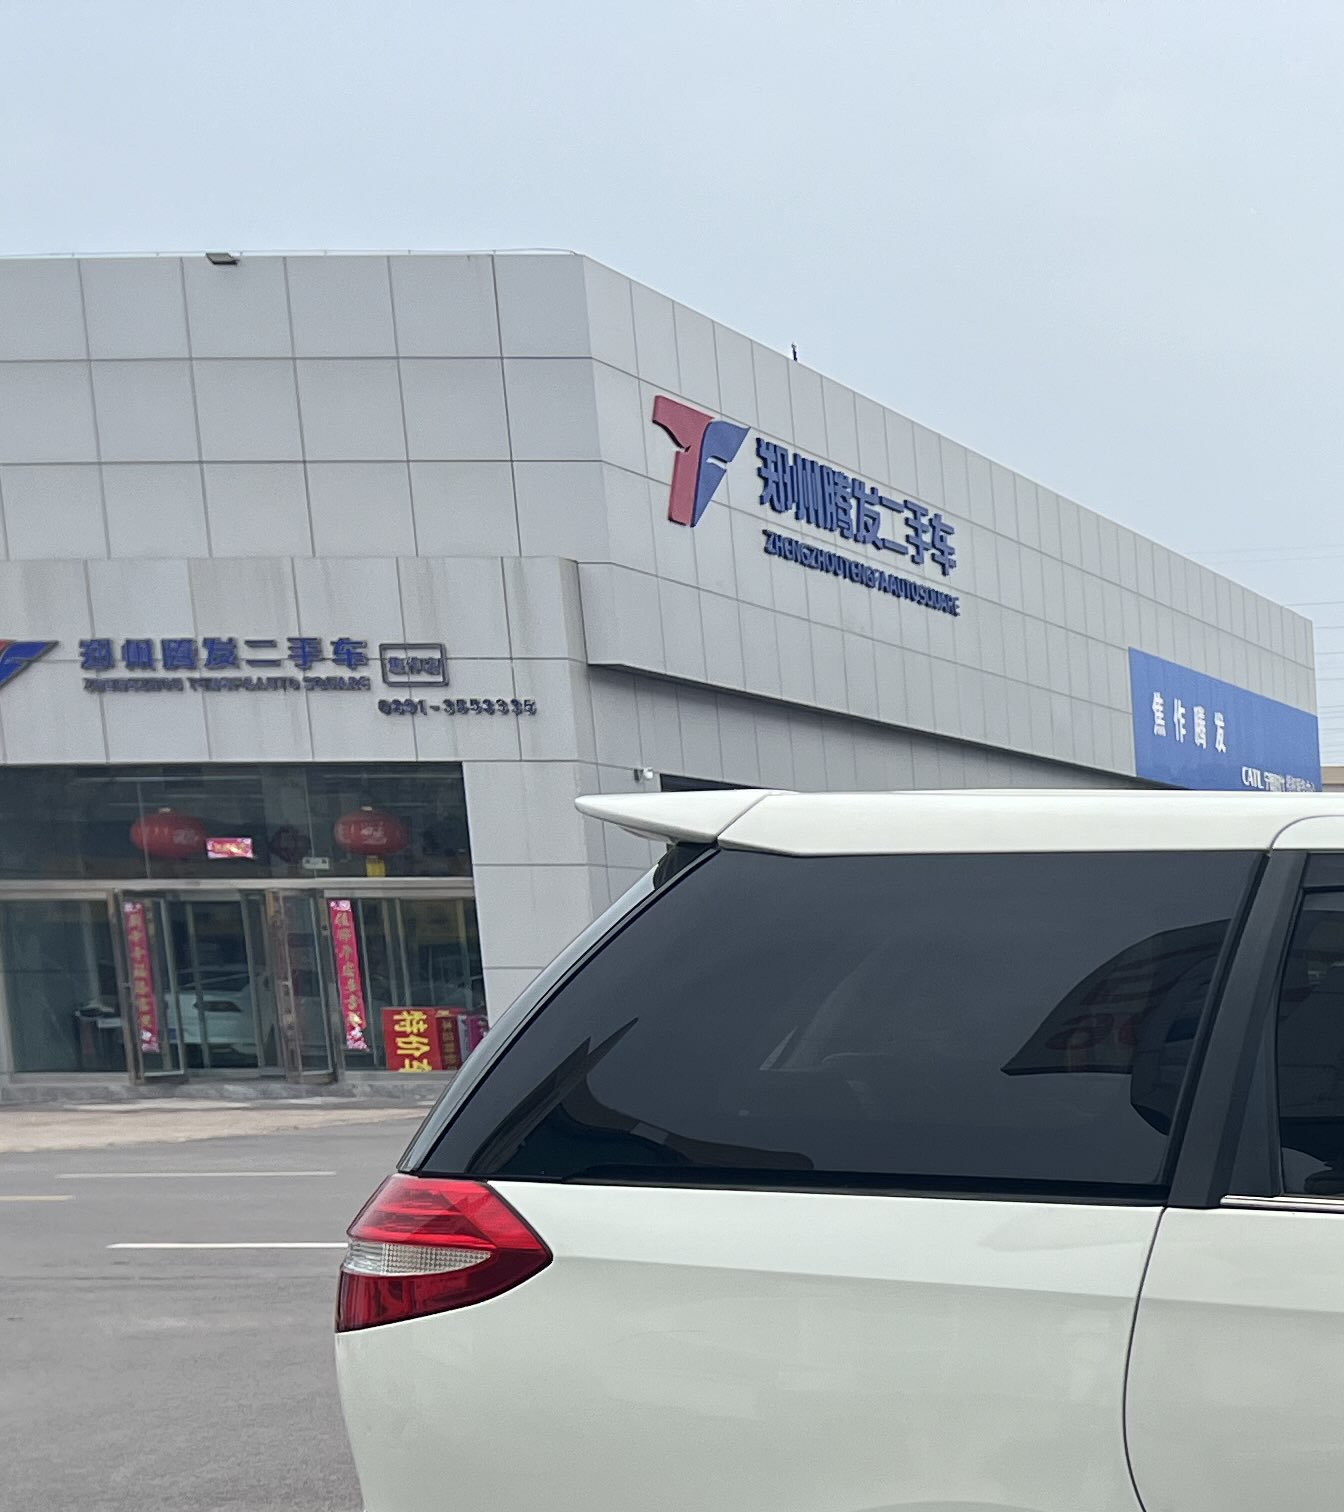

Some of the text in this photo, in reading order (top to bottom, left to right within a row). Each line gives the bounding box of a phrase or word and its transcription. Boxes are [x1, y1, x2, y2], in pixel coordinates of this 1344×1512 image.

[756, 437, 957, 577] 郑州腾发二手车
[1242, 766, 1264, 789] CATL
